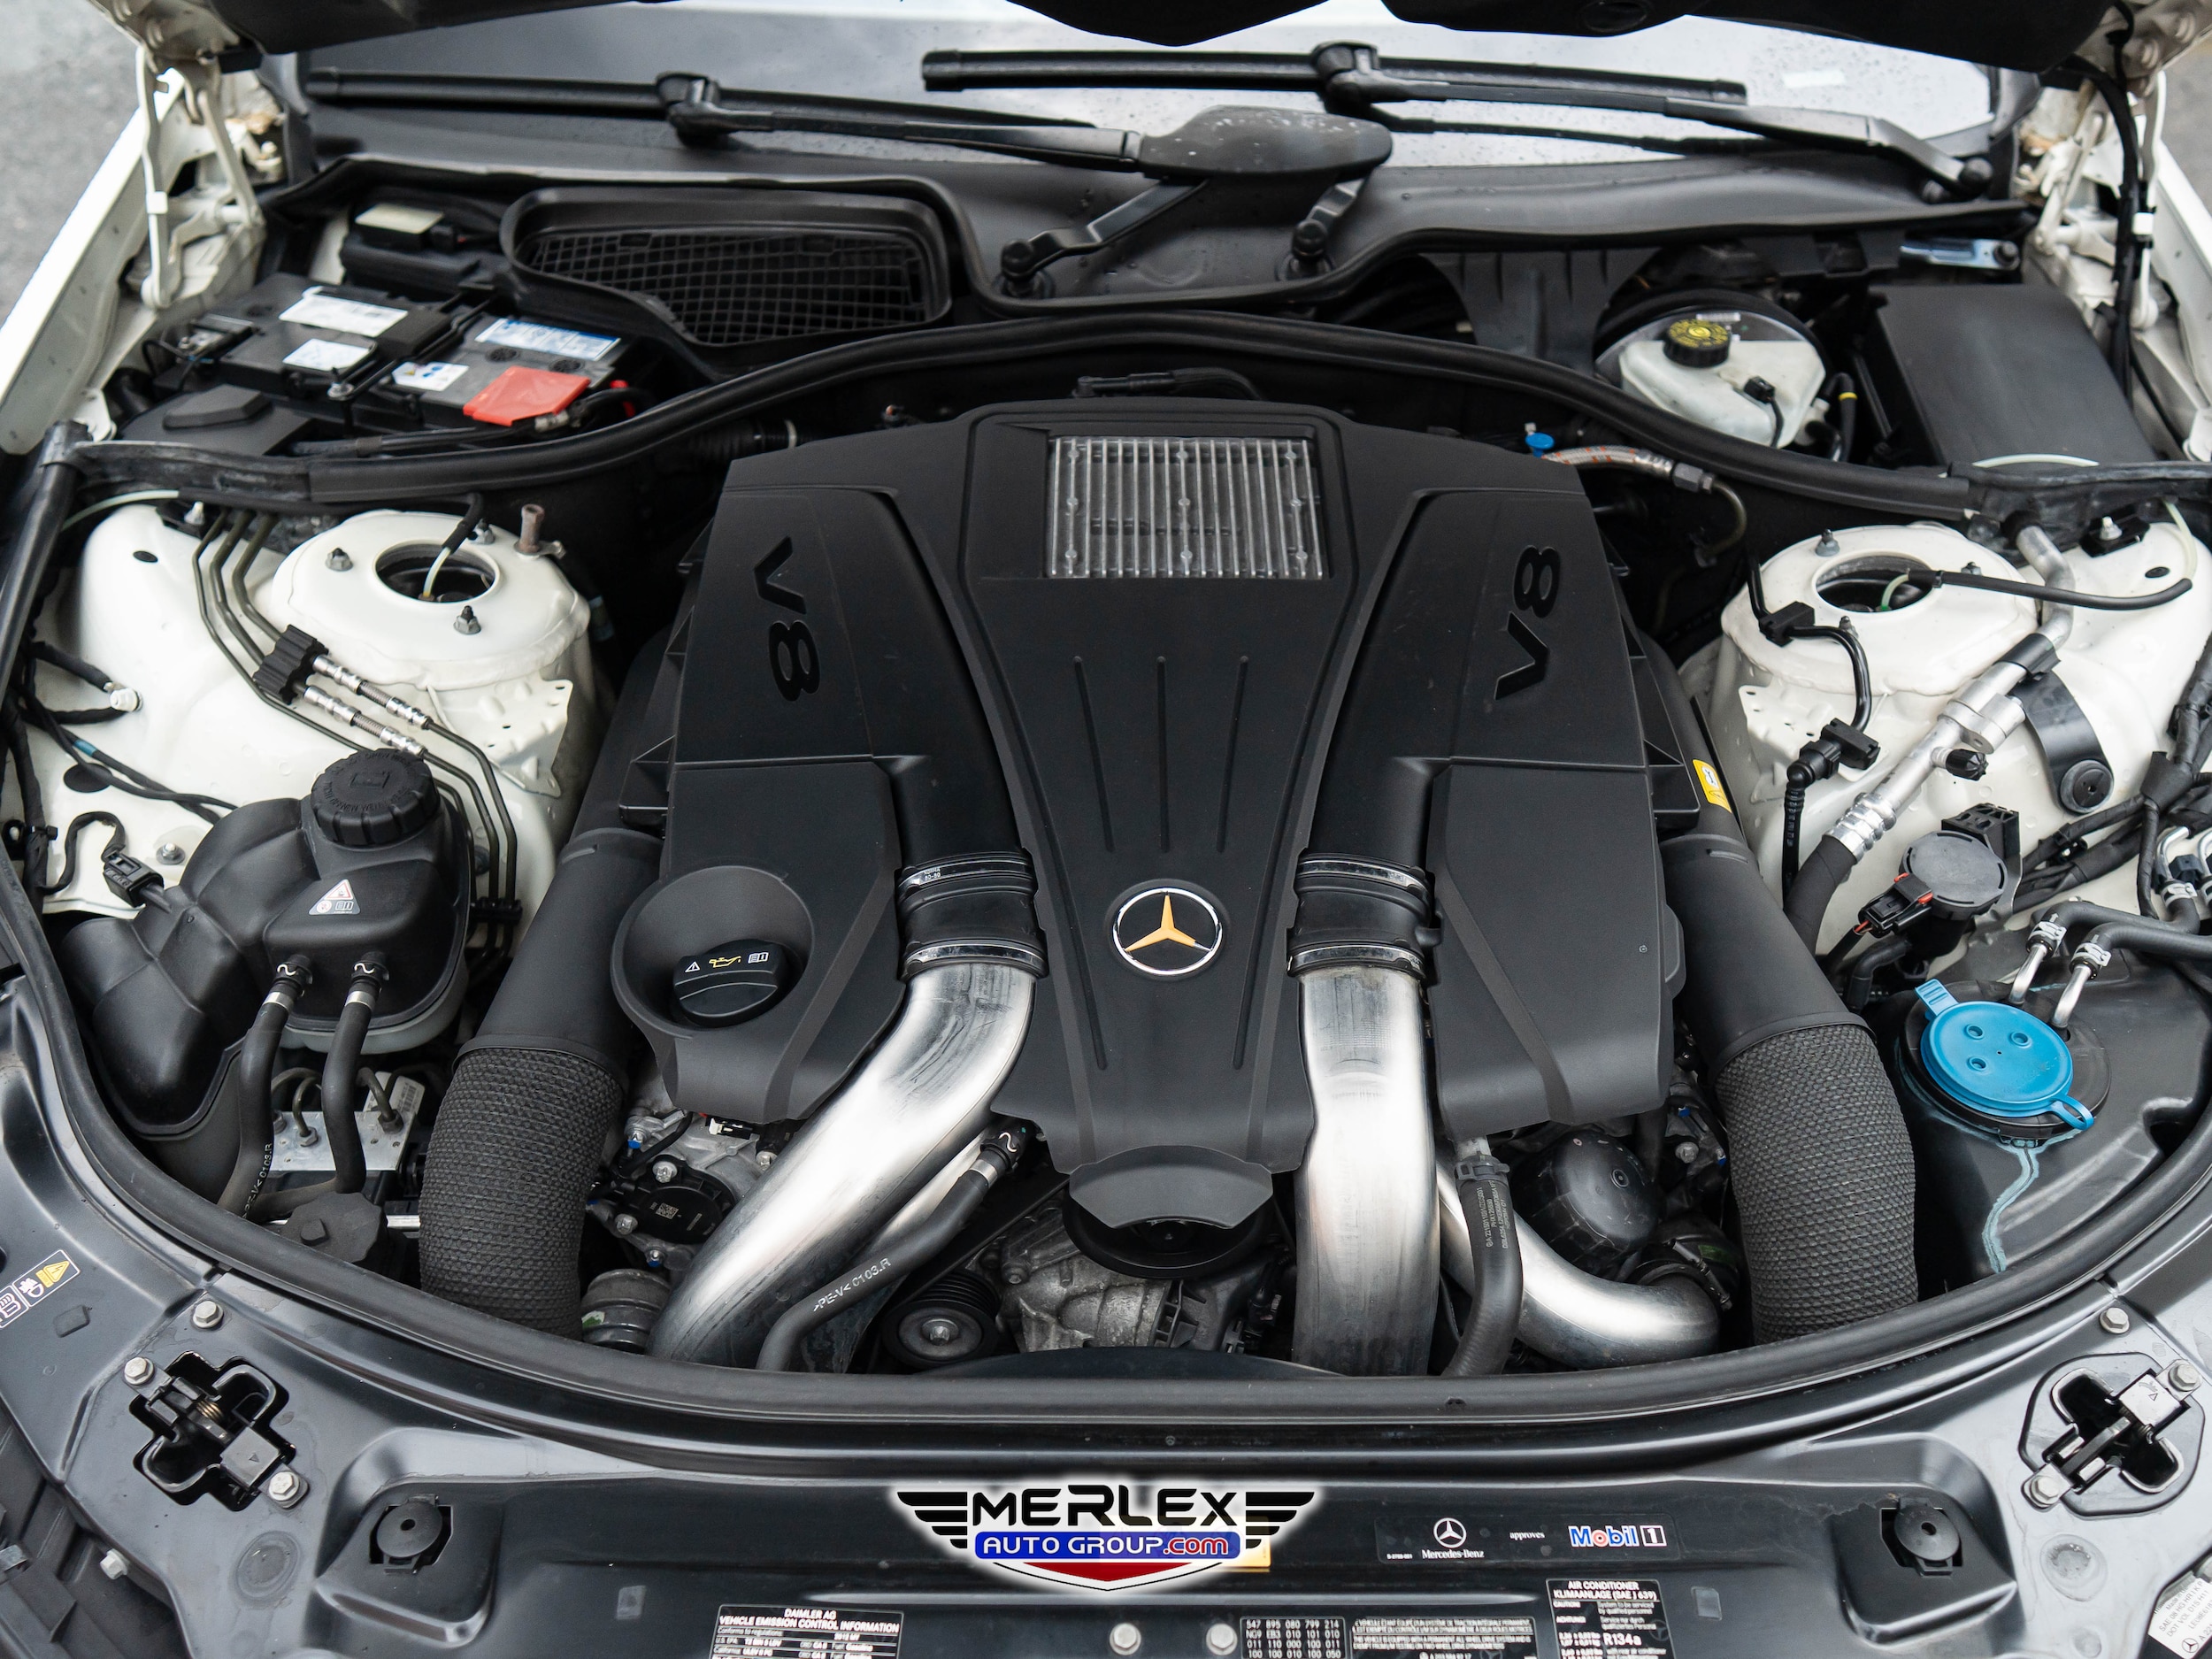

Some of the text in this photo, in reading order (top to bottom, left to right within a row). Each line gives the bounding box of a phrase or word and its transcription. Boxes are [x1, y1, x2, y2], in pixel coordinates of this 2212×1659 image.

[754, 535, 820, 702] V8
[1494, 545, 1561, 701] V8
[1509, 1531, 1545, 1540] approves
[1568, 1525, 1640, 1548] Mobil
[1422, 1549, 1485, 1559] Mercedes-Benz
[1568, 1581, 1640, 1590] AIR CONDITIONER
[1554, 1589, 1612, 1599] KLIMAANLAGE
[784, 1609, 837, 1620] DAIMLER AG
[719, 1616, 900, 1632] VEHICLE EMISSION CONTROL INFORMATION
[1246, 1619, 1340, 1629] 547 895 080 799 214
[2159, 1618, 2171, 1632] SAE
[1286, 1629, 1302, 1639] 010
[1306, 1629, 1320, 1639] 101
[1325, 1629, 1340, 1639] 010
[2167, 1624, 2179, 1637] DOT
[1247, 1640, 1340, 1648] 011 110 000 100 011
[1602, 1632, 1642, 1646] R134a
[1248, 1649, 1341, 1659] 100 100 010 100 050
